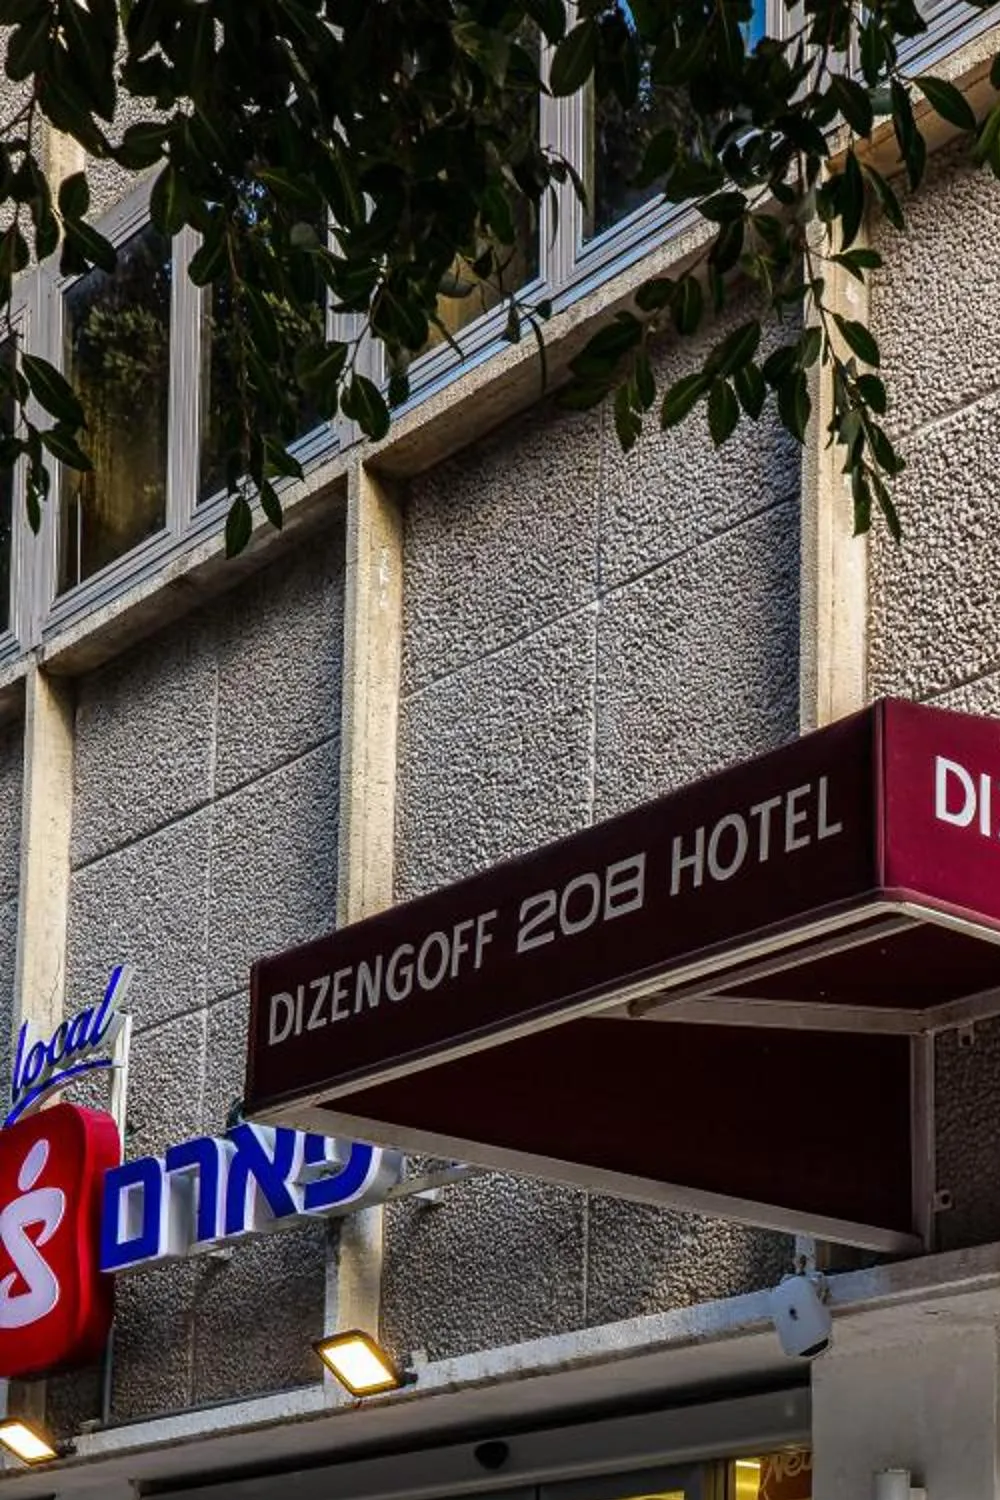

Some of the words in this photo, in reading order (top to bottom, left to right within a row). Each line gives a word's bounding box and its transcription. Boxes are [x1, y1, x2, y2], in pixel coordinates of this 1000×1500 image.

[267, 908, 498, 1047] DIZENGOFF
[516, 851, 647, 954] 208
[669, 775, 843, 897] HOTEL
[12, 963, 126, 1098] local
[100, 1122, 374, 1271] פארם
